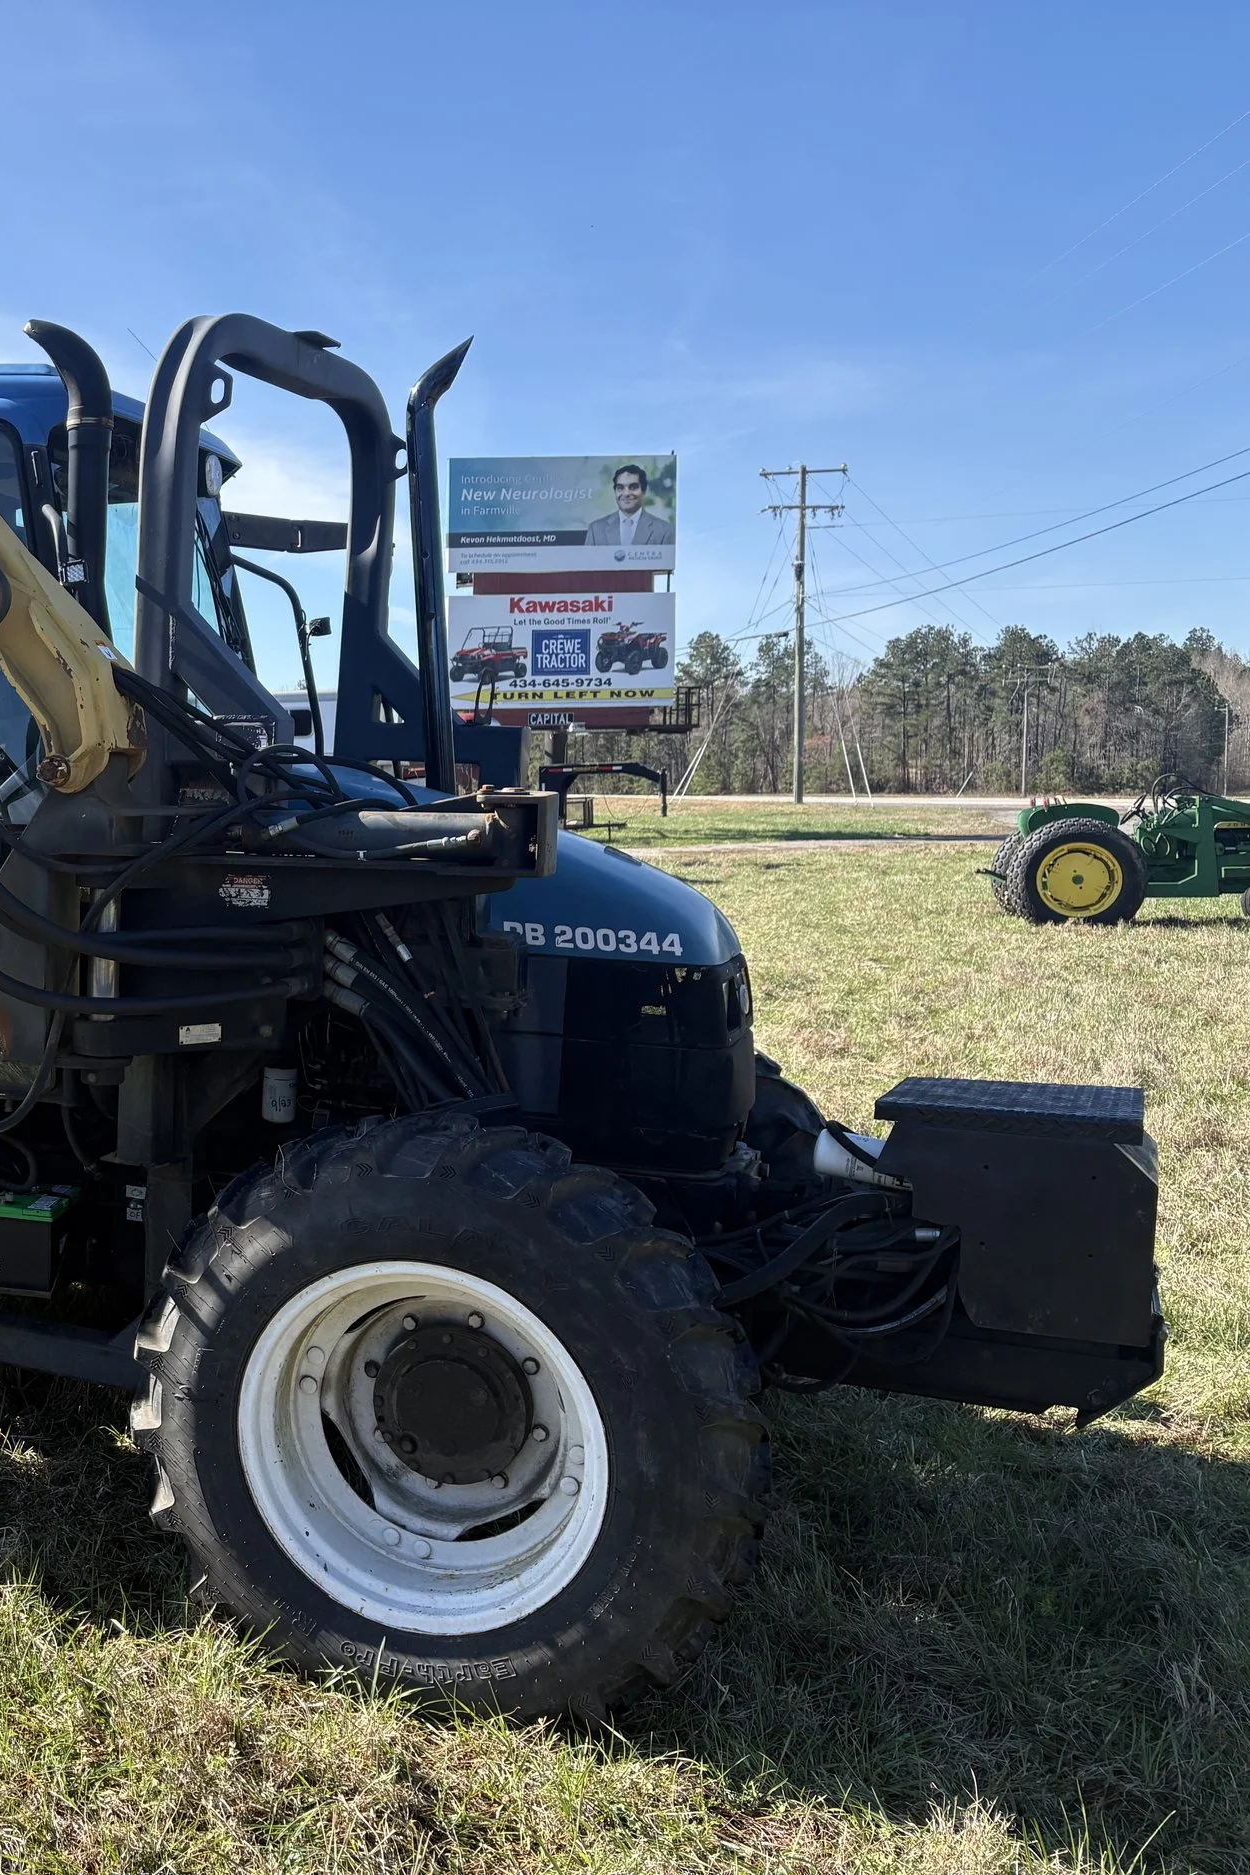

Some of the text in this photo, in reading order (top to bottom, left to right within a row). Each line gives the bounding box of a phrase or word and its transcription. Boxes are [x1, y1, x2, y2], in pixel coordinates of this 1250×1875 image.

[461, 474, 522, 485] Introducing
[461, 486, 594, 502] New Neurologist
[461, 505, 521, 516] in Farmville
[460, 536, 485, 544] Kevon
[509, 595, 613, 614] Kawasaki
[513, 618, 527, 626] Let
[543, 617, 565, 626] Good
[567, 617, 591, 625] Times
[541, 638, 582, 655] CREWE
[536, 653, 586, 669] TRACTOR
[508, 677, 613, 690] 434-645-9734
[492, 689, 655, 700] TURN LEFT NOW
[530, 712, 574, 726] CAPITAL
[554, 925, 683, 957] 200344
[340, 1641, 518, 1684] Earth-Pro
